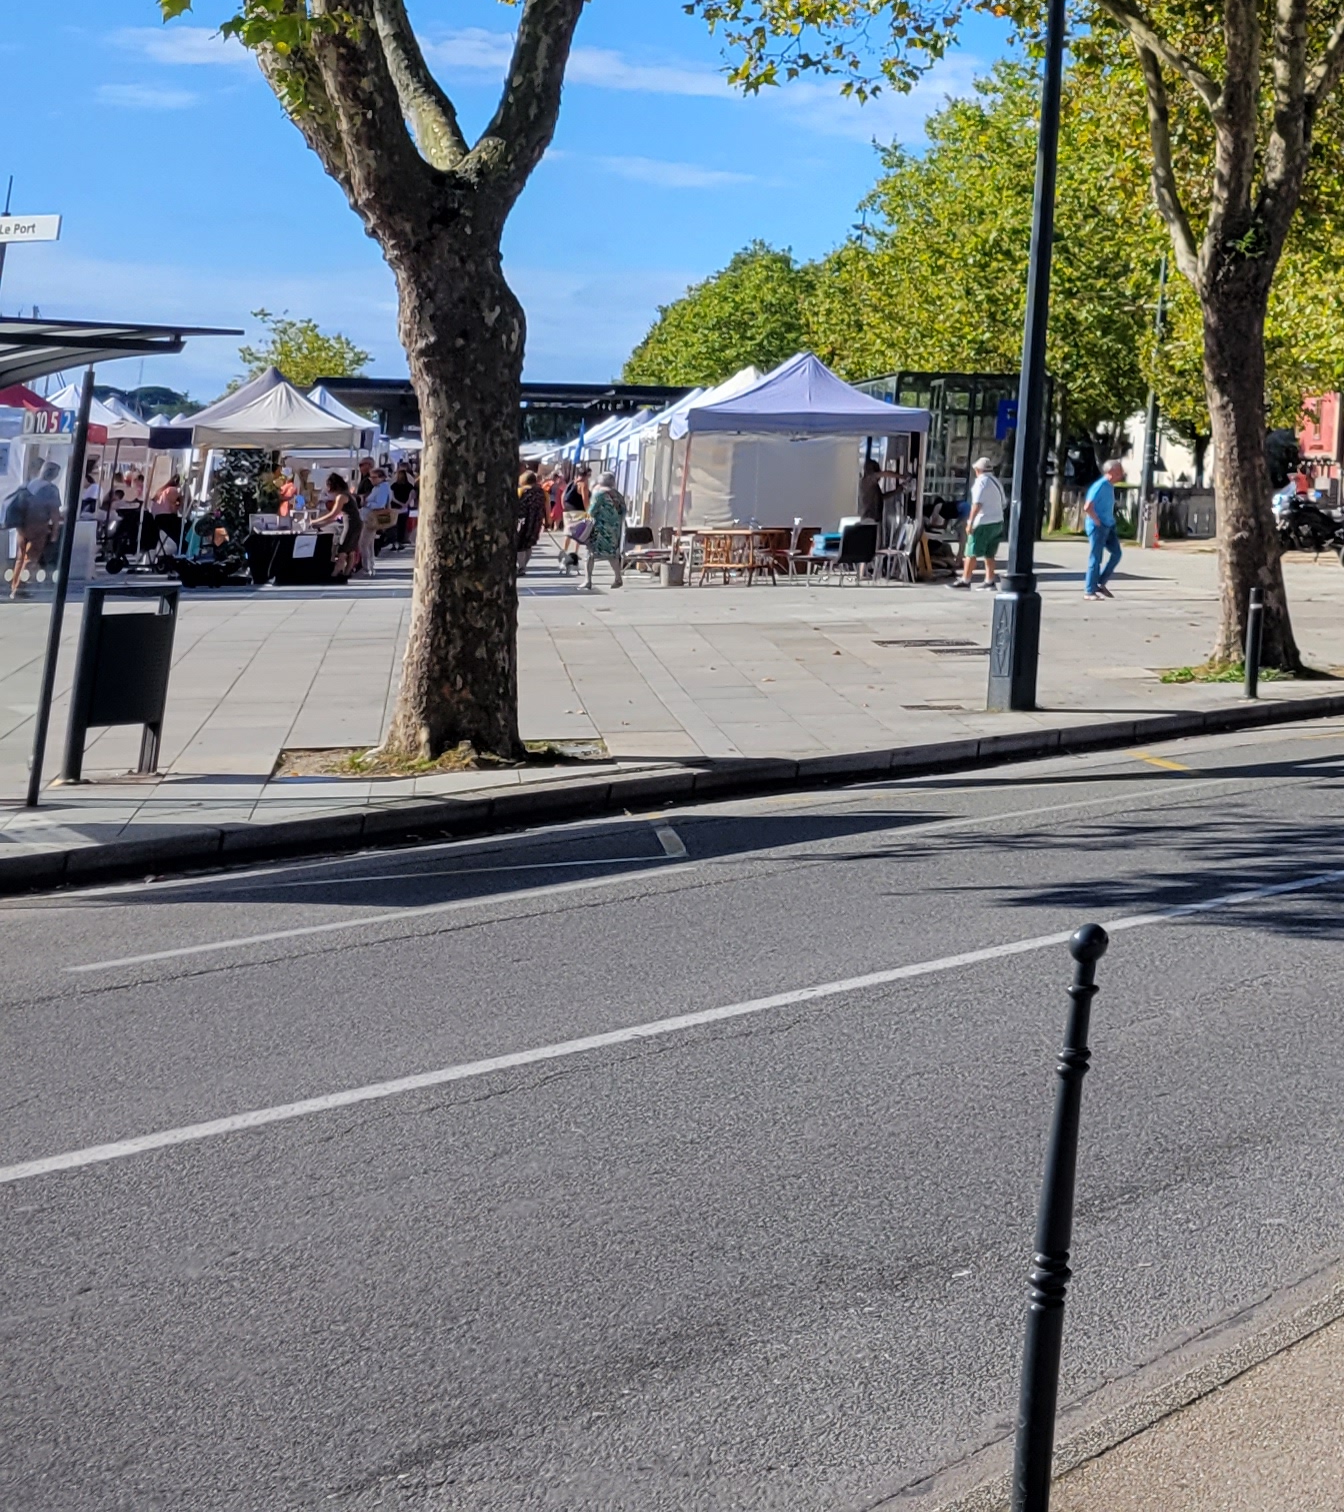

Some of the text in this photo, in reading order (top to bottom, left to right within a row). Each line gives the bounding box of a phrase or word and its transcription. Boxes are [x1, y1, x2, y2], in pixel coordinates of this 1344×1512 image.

[13, 223, 36, 235] Port
[49, 411, 59, 433] 5
[62, 411, 71, 433] 2
